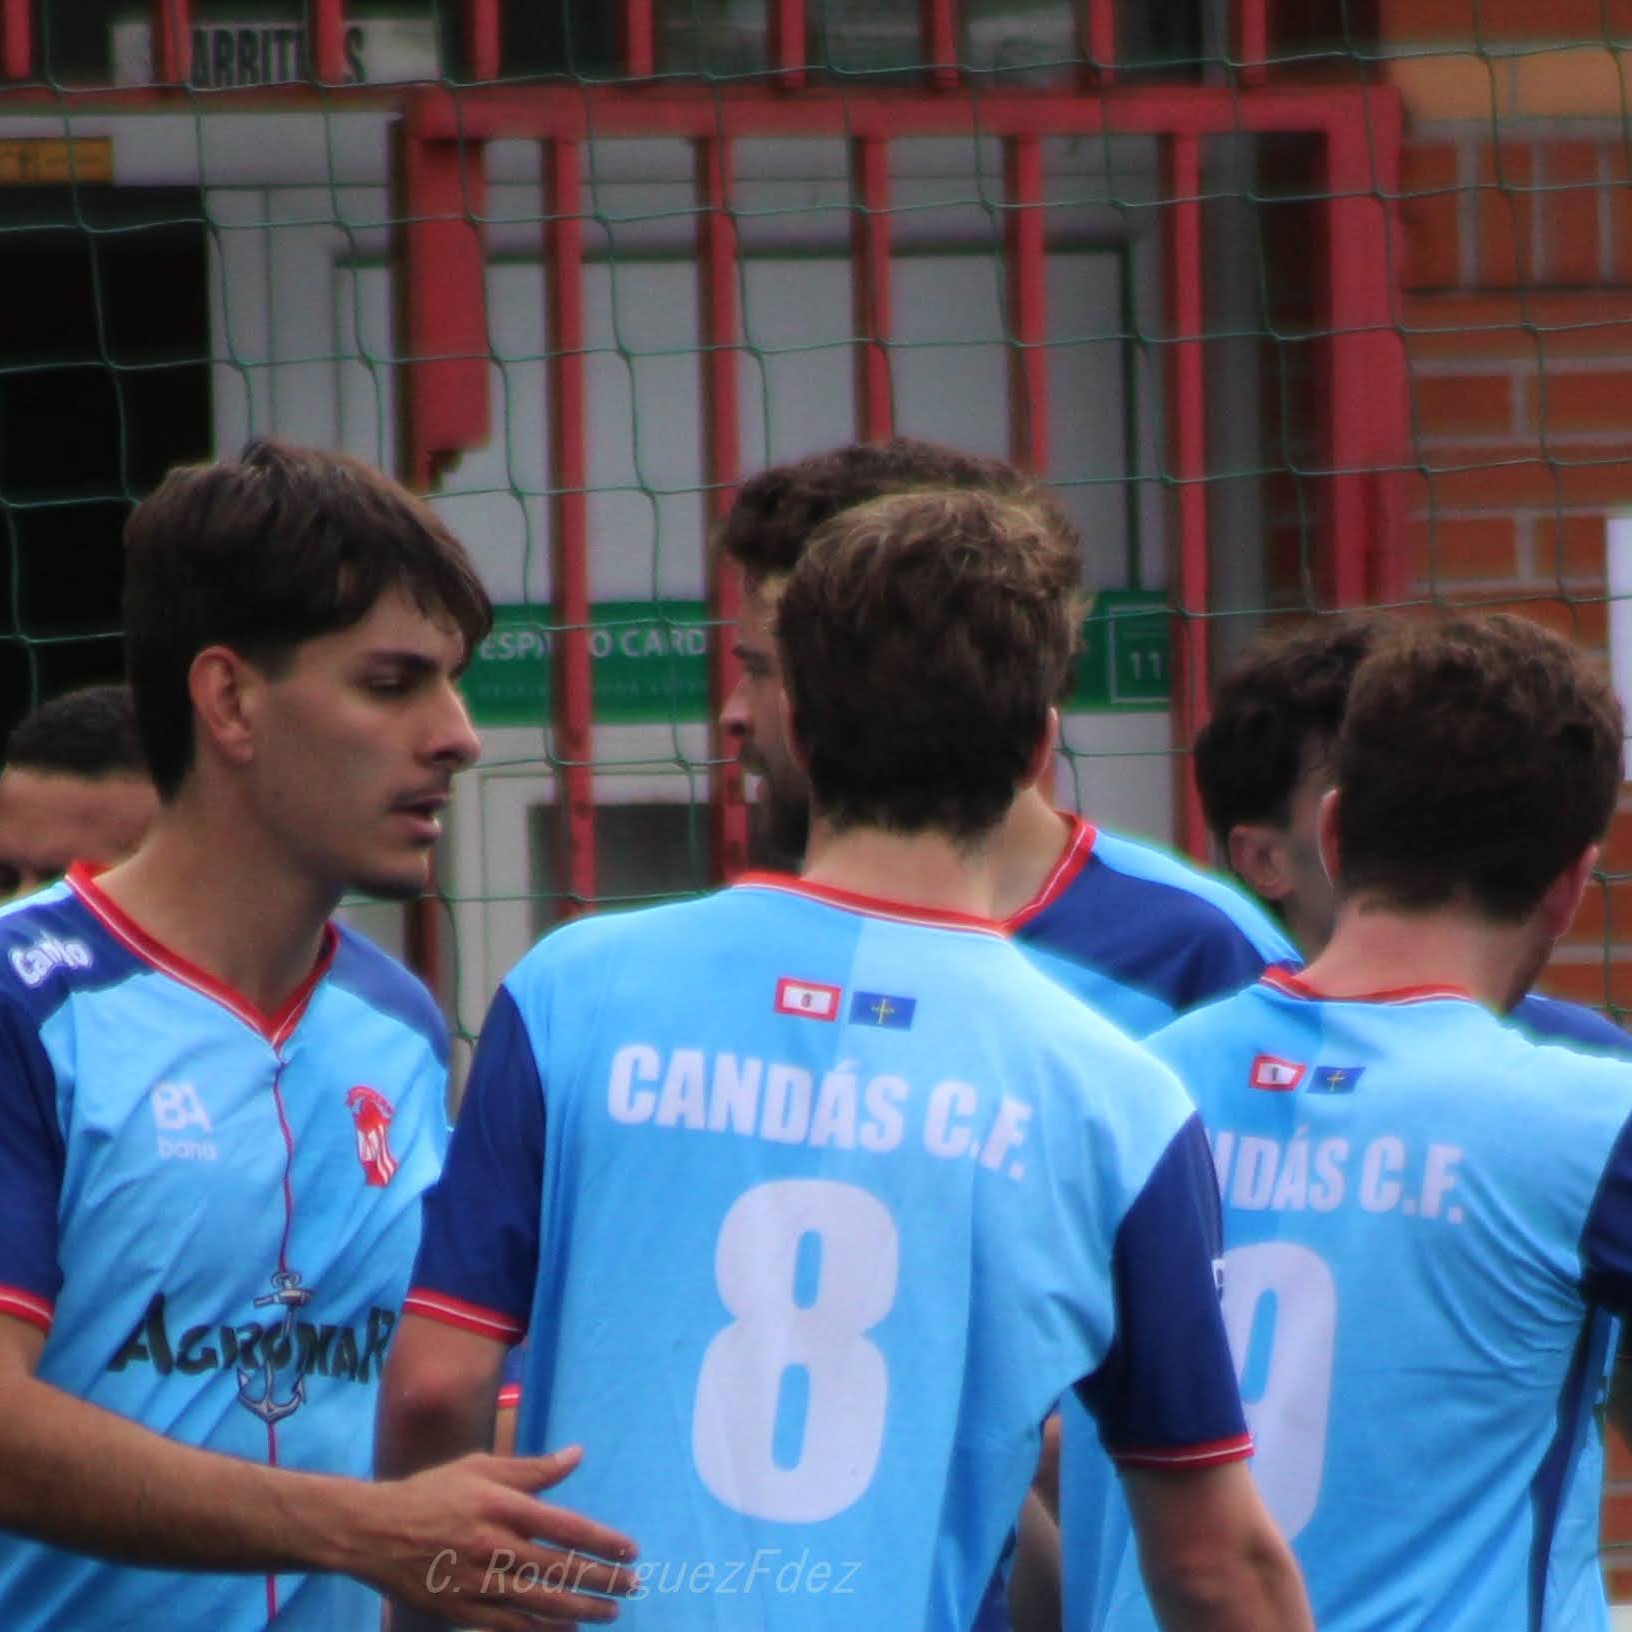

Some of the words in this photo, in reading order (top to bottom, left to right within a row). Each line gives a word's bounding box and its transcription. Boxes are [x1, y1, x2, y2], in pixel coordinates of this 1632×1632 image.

[479, 627, 610, 661] ESPO
[607, 1043, 911, 1154] CANDÁS
[922, 1080, 1035, 1183] C.F.
[1205, 1124, 1350, 1213] NDÁS
[1359, 1134, 1464, 1225] C.F.
[692, 1180, 898, 1523] 8
